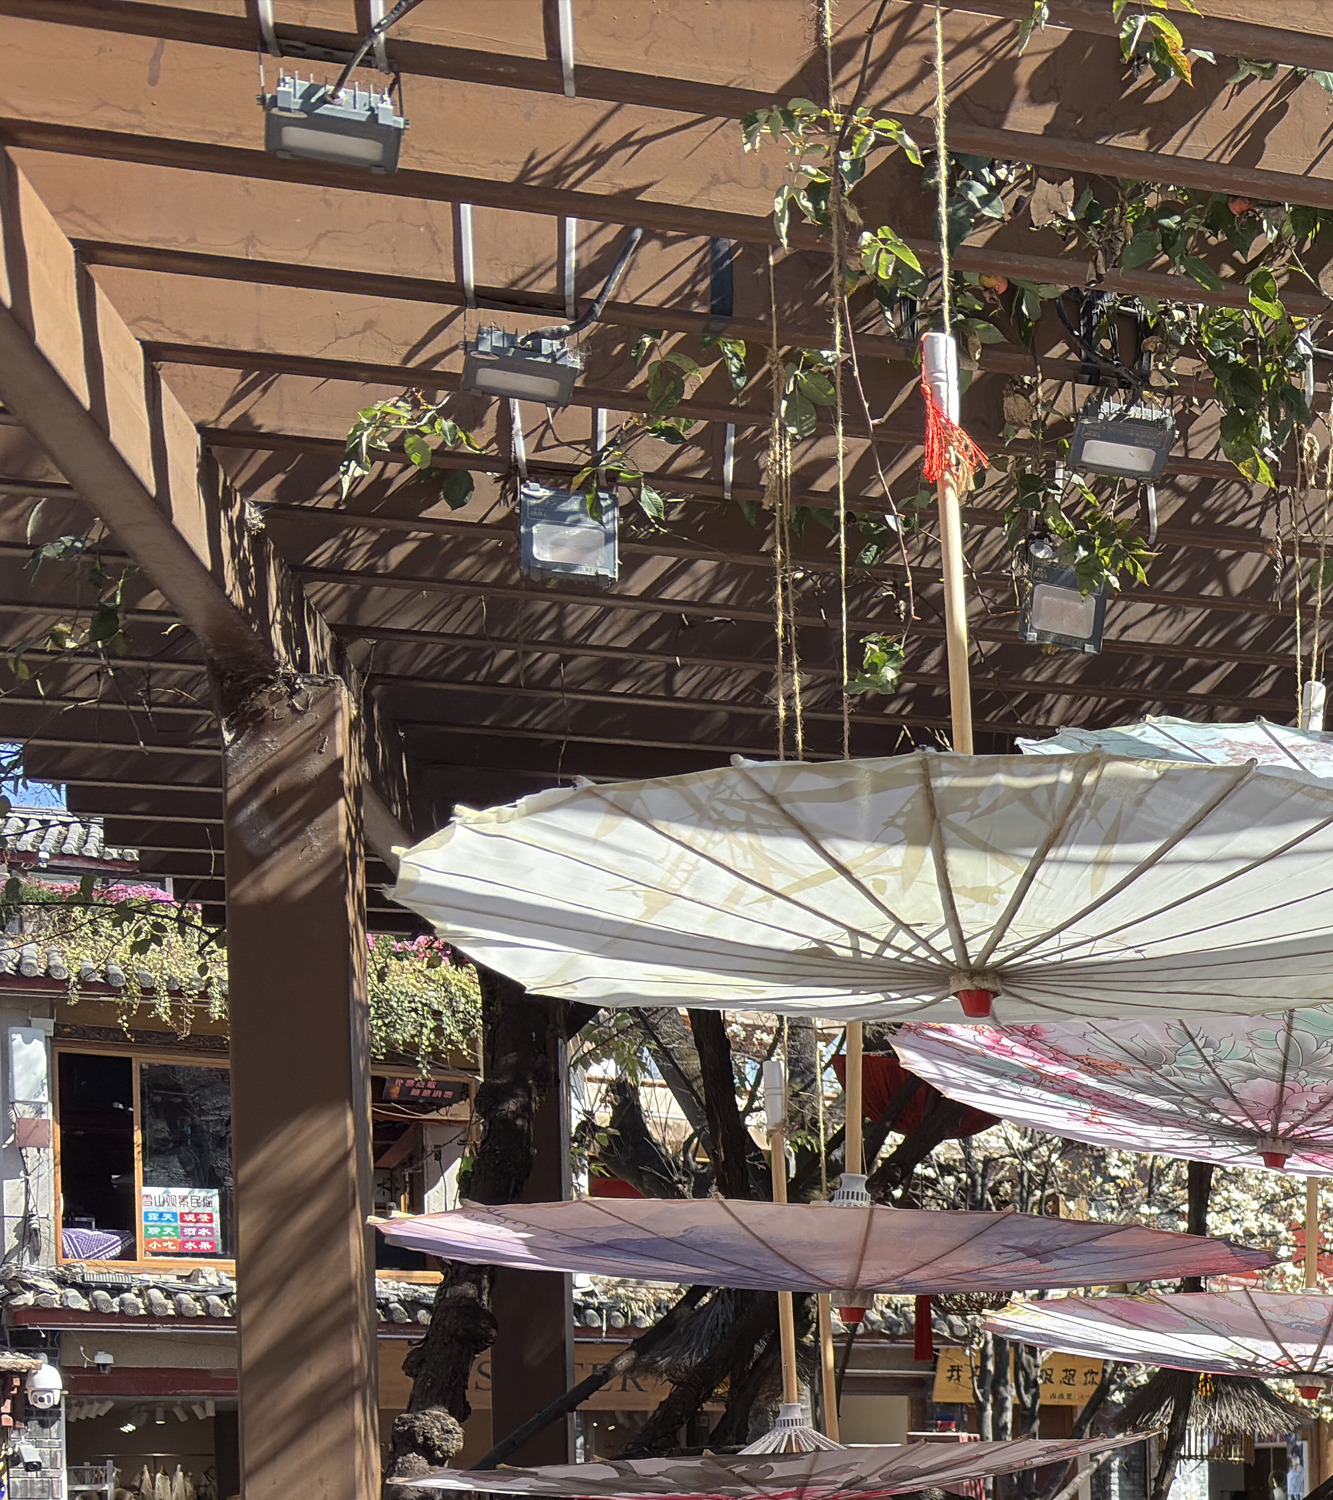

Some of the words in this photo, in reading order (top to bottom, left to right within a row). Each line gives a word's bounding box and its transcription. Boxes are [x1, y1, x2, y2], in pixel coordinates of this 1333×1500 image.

[147, 1212, 175, 1222] 露天
[147, 1226, 176, 1236] 聊天
[183, 1227, 212, 1236] 酒水
[148, 1240, 177, 1249] 小吃
[184, 1241, 212, 1250] 水果
